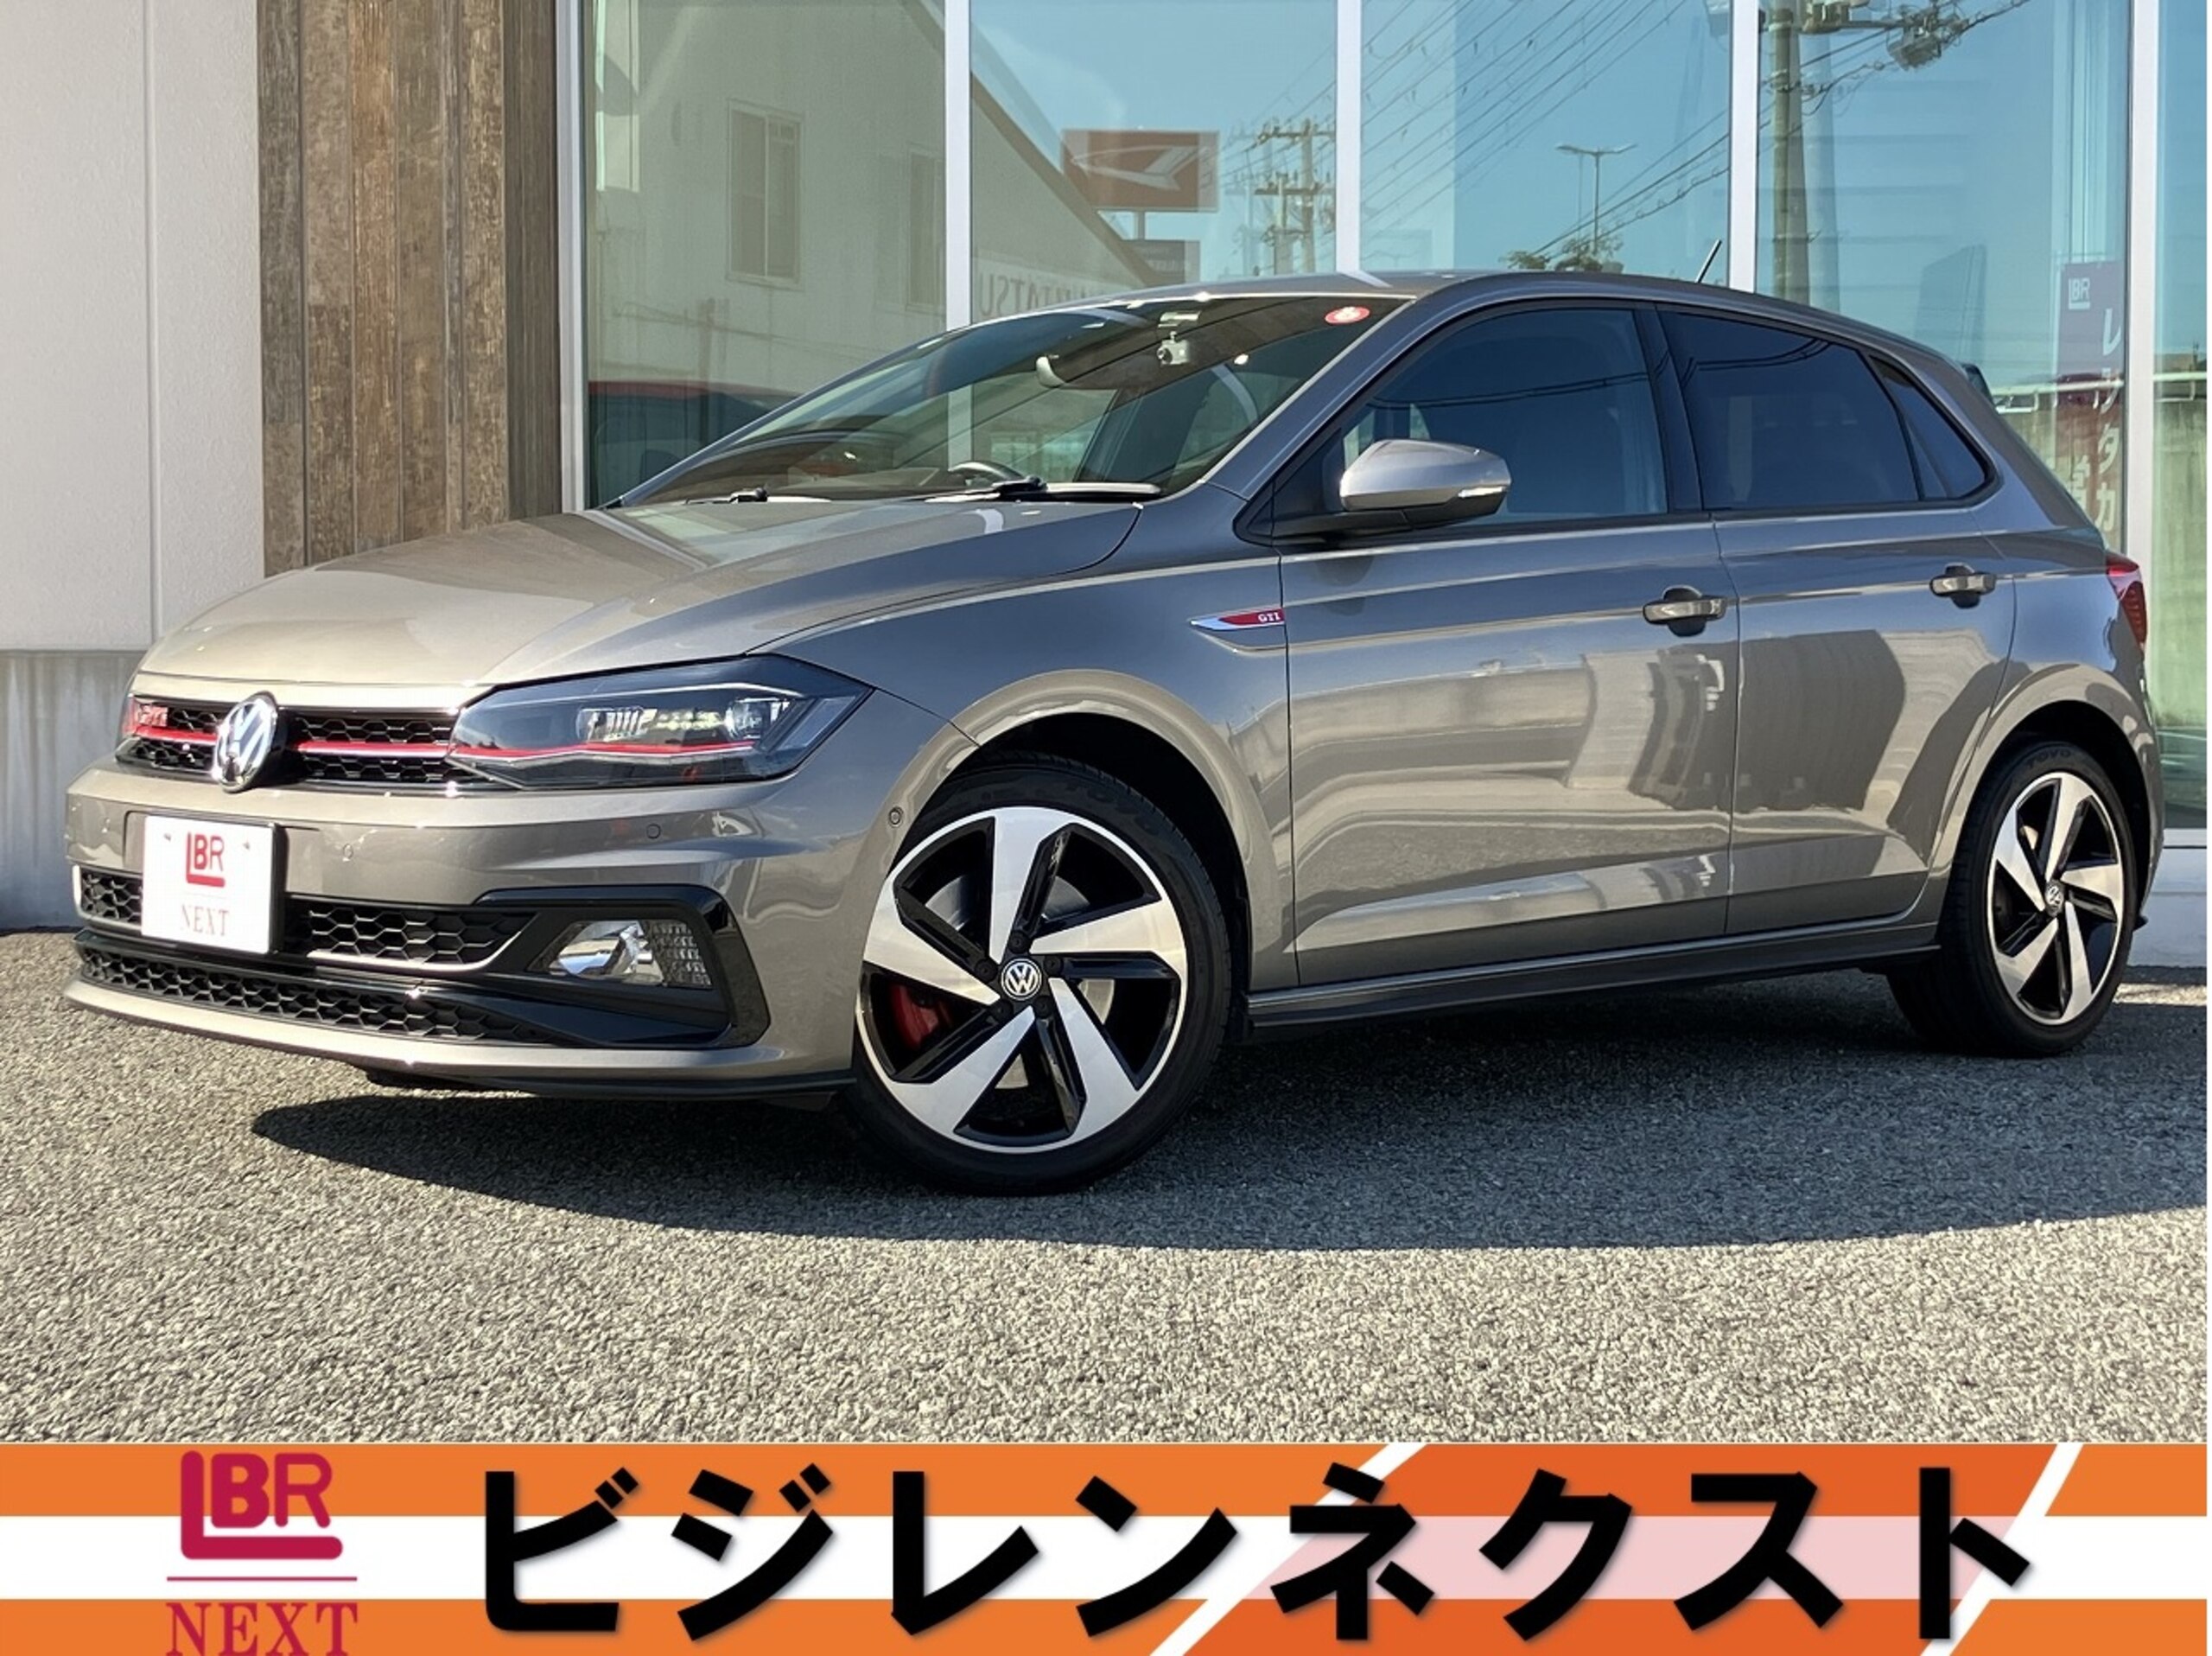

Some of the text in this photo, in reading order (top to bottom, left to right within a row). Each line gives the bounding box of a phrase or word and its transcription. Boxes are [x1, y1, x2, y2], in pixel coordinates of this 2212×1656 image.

[1257, 611, 1281, 622] GTI
[186, 831, 226, 888] LBR
[181, 904, 229, 936] NEXT
